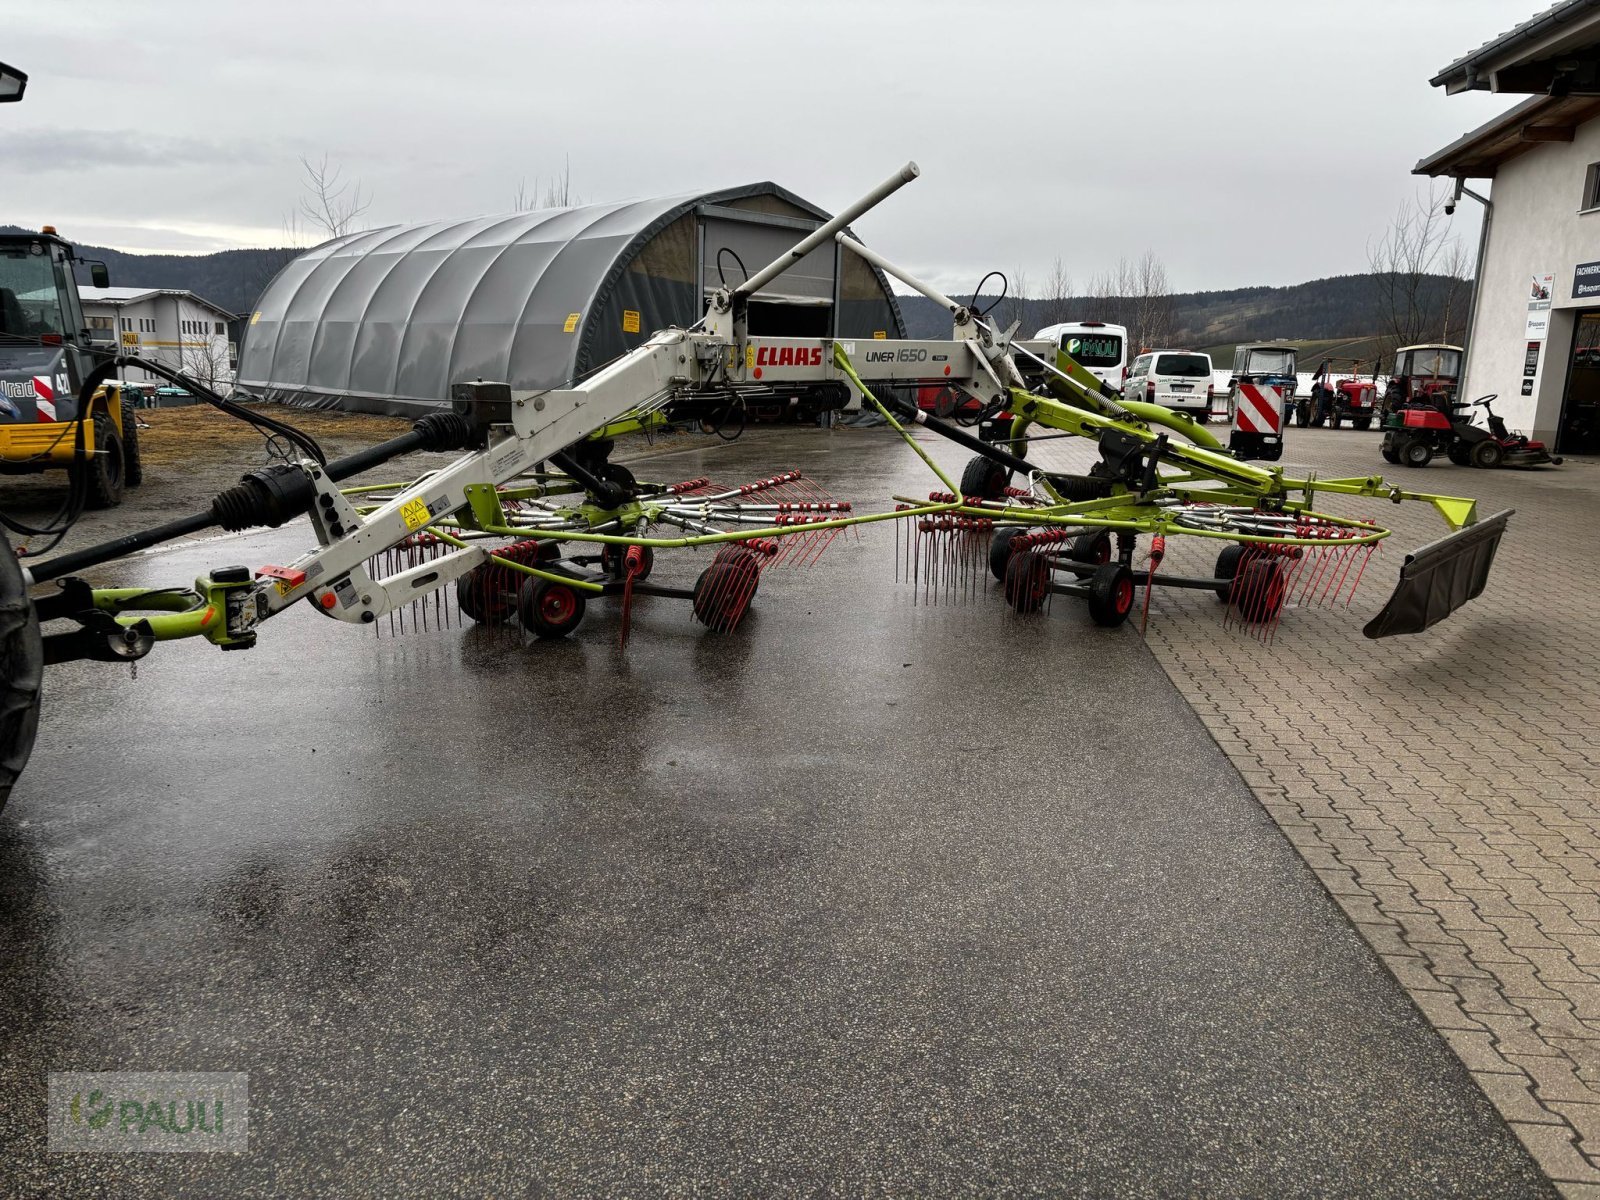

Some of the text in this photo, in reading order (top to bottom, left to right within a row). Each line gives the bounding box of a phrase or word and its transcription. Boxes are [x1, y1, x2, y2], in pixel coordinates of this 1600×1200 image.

[756, 347, 822, 366] CLAAS
[866, 352, 895, 363] LINER
[896, 349, 927, 362] 1650
